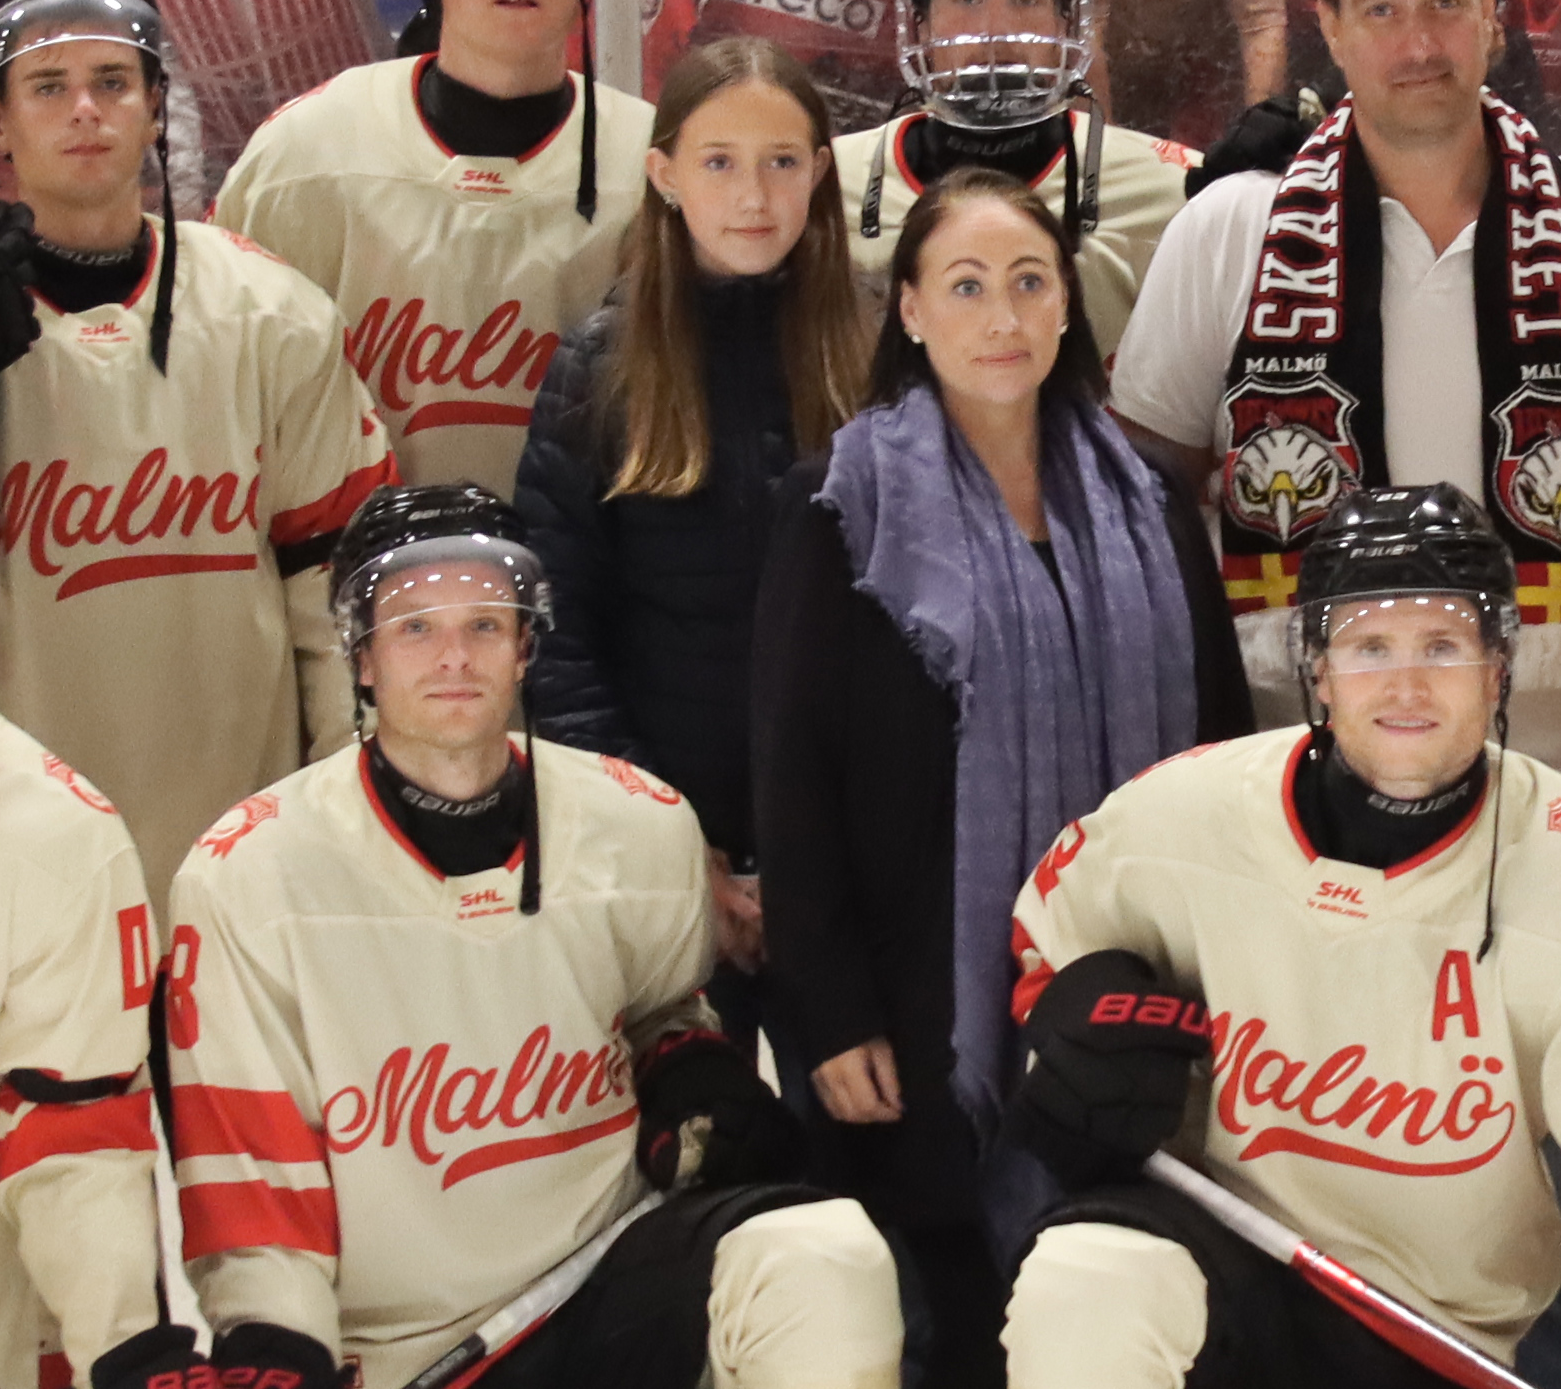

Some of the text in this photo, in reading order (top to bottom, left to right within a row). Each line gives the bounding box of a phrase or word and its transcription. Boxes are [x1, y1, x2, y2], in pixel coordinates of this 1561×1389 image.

[461, 169, 506, 185] SHL
[79, 321, 122, 336] SHL
[1245, 353, 1328, 374] MALMÖ
[1367, 781, 1472, 816] BAUER
[459, 888, 504, 907] SHL
[1315, 880, 1364, 904] SHL
[1431, 948, 1481, 1042] A
[1089, 993, 1213, 1037] BAU
[1209, 1011, 1517, 1151] Malmö
